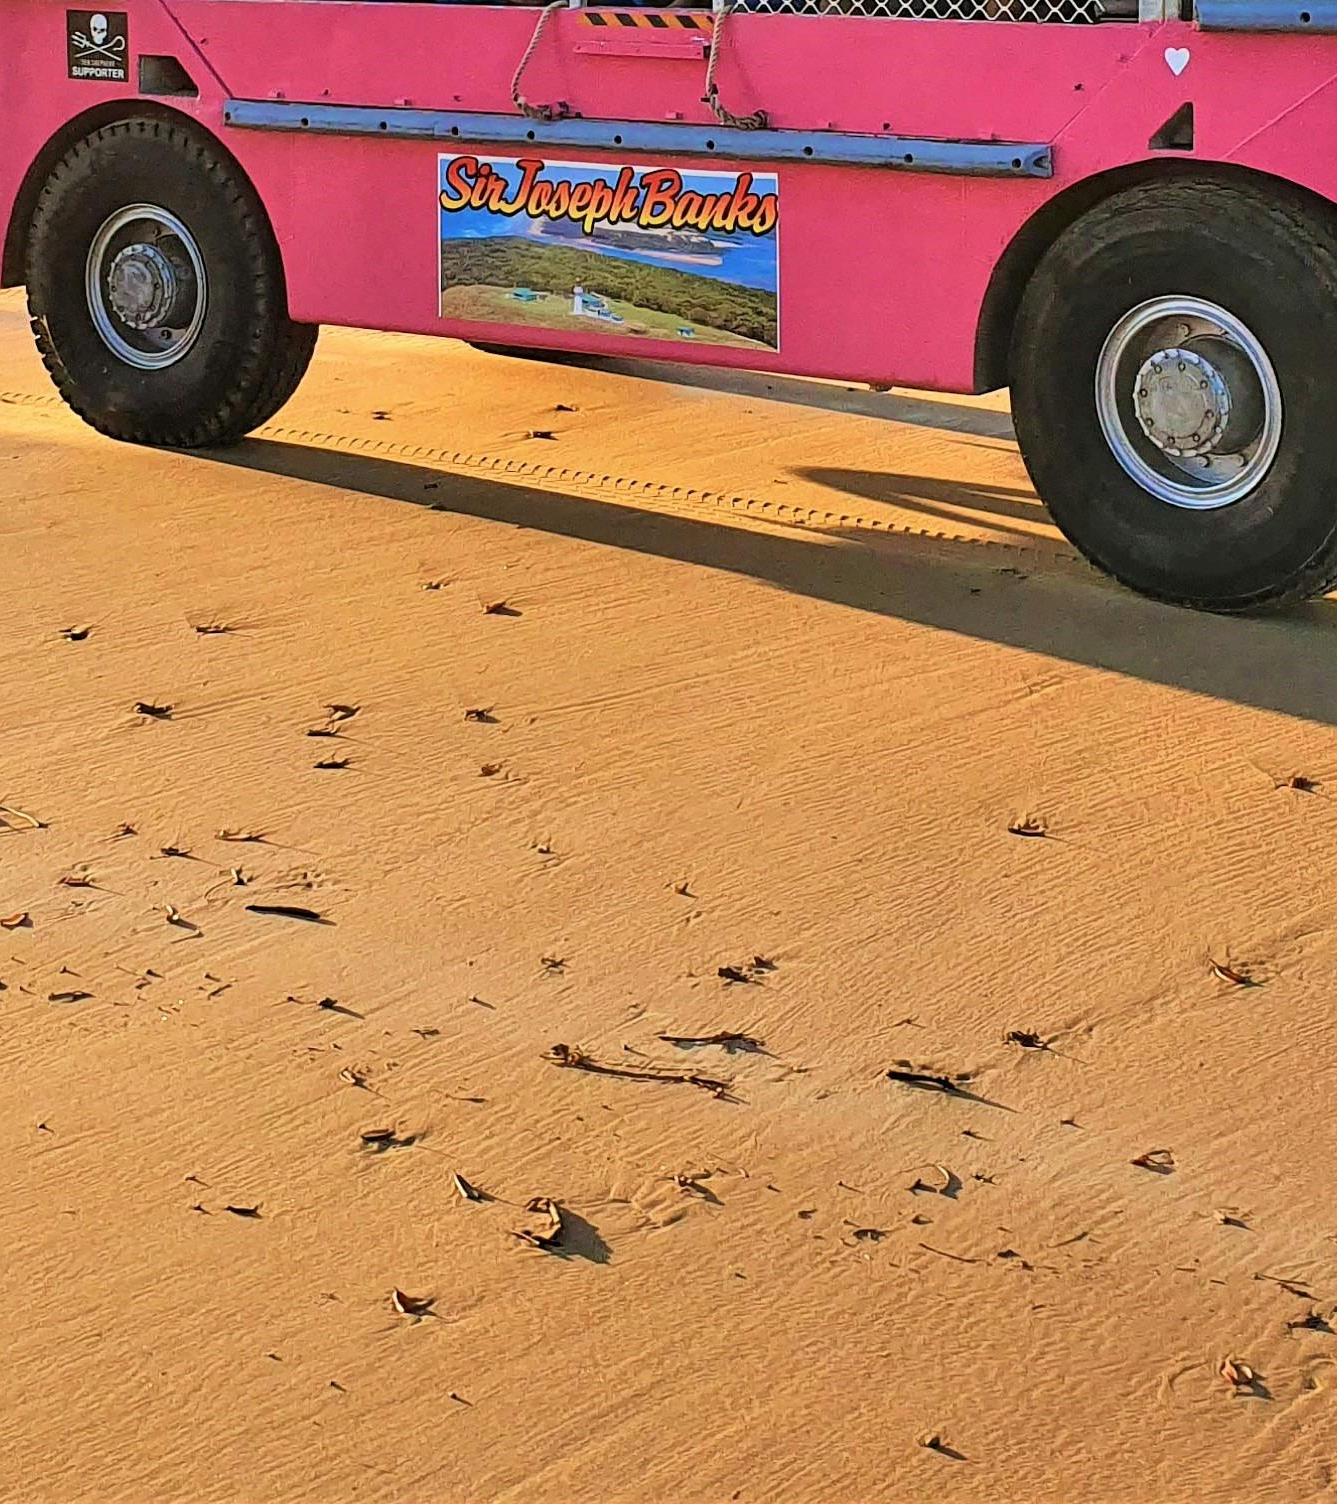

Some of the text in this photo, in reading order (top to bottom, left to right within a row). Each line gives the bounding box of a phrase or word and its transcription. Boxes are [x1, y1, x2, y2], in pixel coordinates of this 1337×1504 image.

[72, 65, 125, 79] SUPPORTER
[439, 156, 779, 237] Sir Joseph Banks
